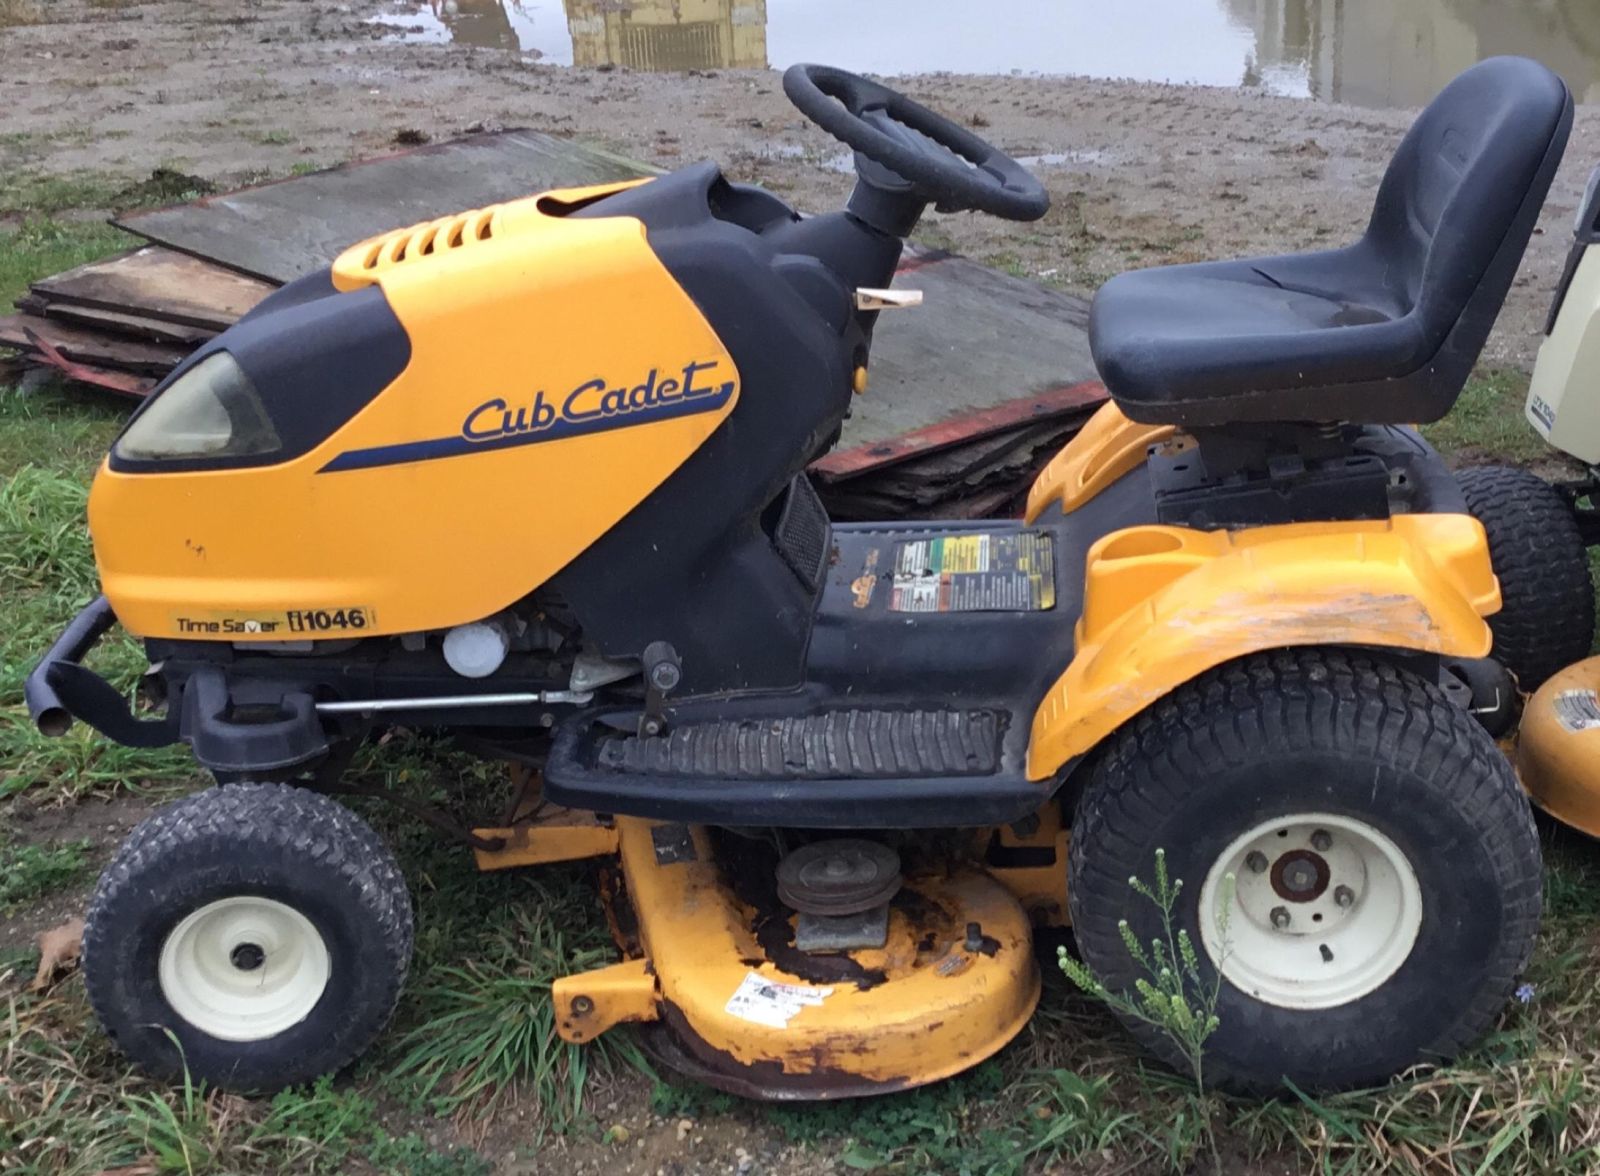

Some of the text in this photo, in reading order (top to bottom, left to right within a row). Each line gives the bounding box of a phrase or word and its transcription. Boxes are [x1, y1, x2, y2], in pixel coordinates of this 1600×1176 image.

[462, 361, 719, 437] Cub Cadet
[177, 618, 220, 633] Time
[223, 618, 280, 634] Saver
